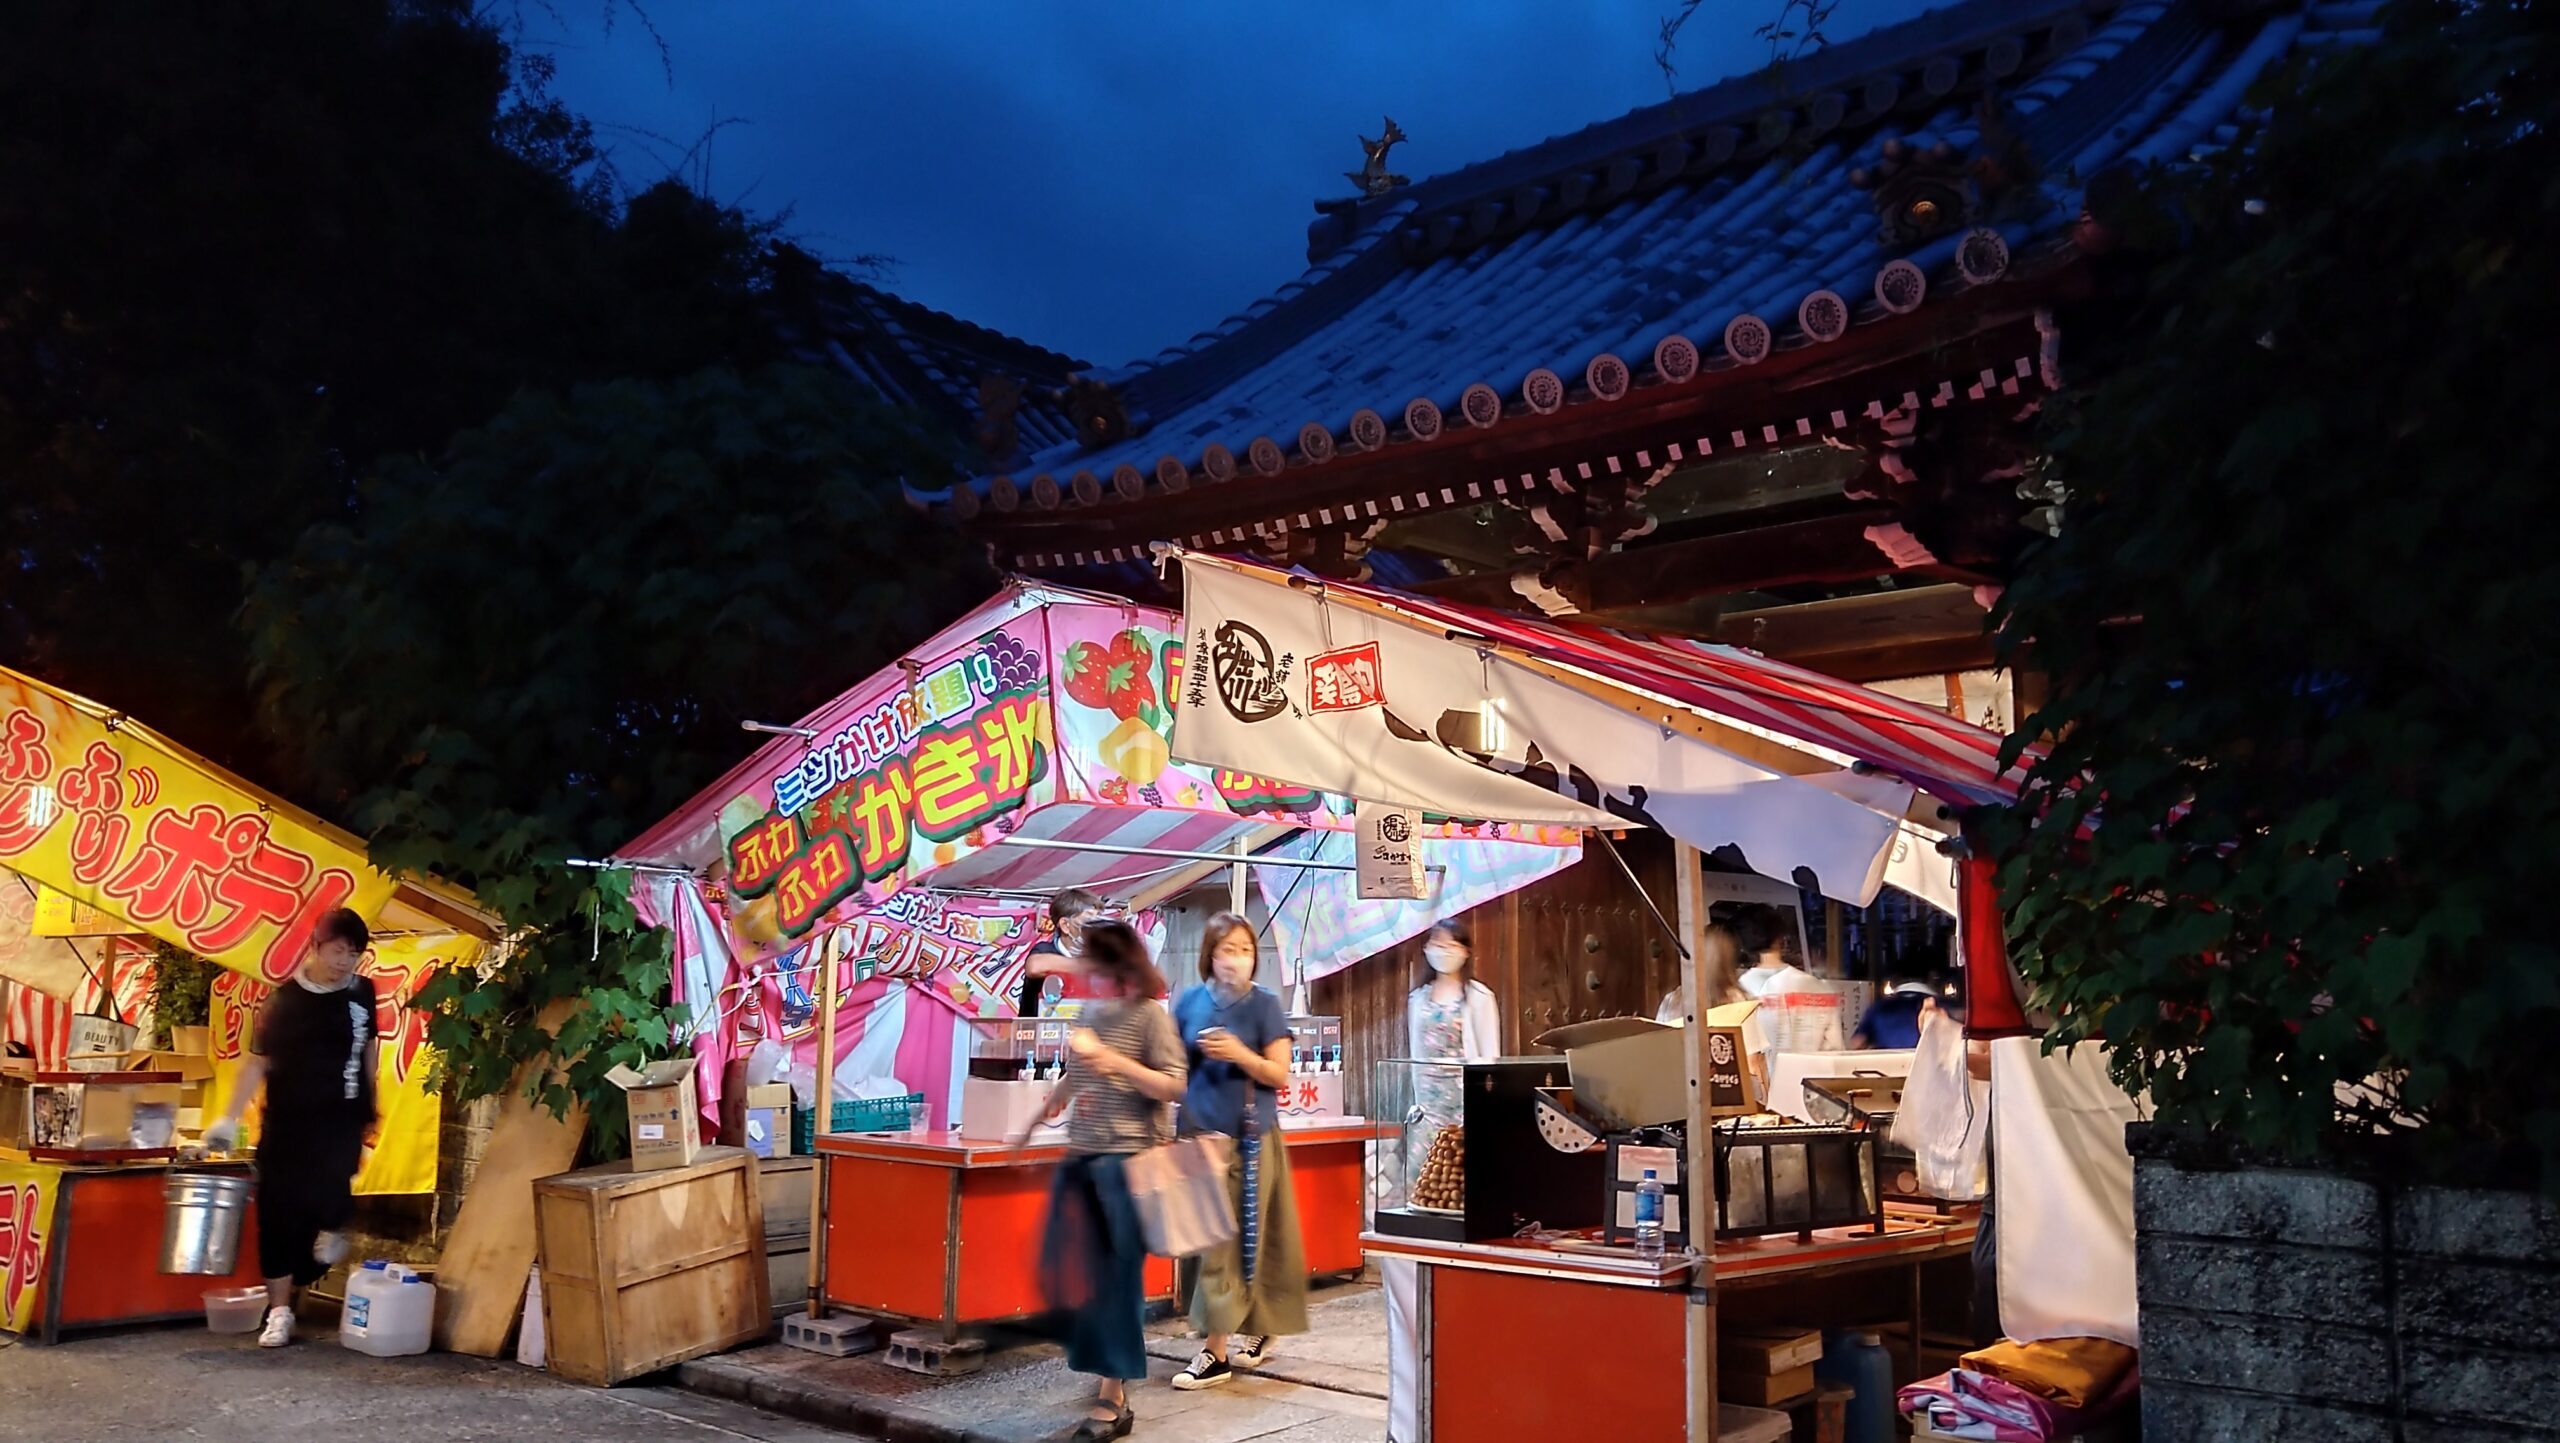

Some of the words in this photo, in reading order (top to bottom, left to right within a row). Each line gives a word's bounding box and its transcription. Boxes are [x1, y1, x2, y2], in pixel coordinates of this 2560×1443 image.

[854, 700, 1038, 866] かき氷
[734, 818, 797, 885] ふわ
[779, 845, 846, 922] ふわ
[83, 1031, 120, 1046] BEAUTY
